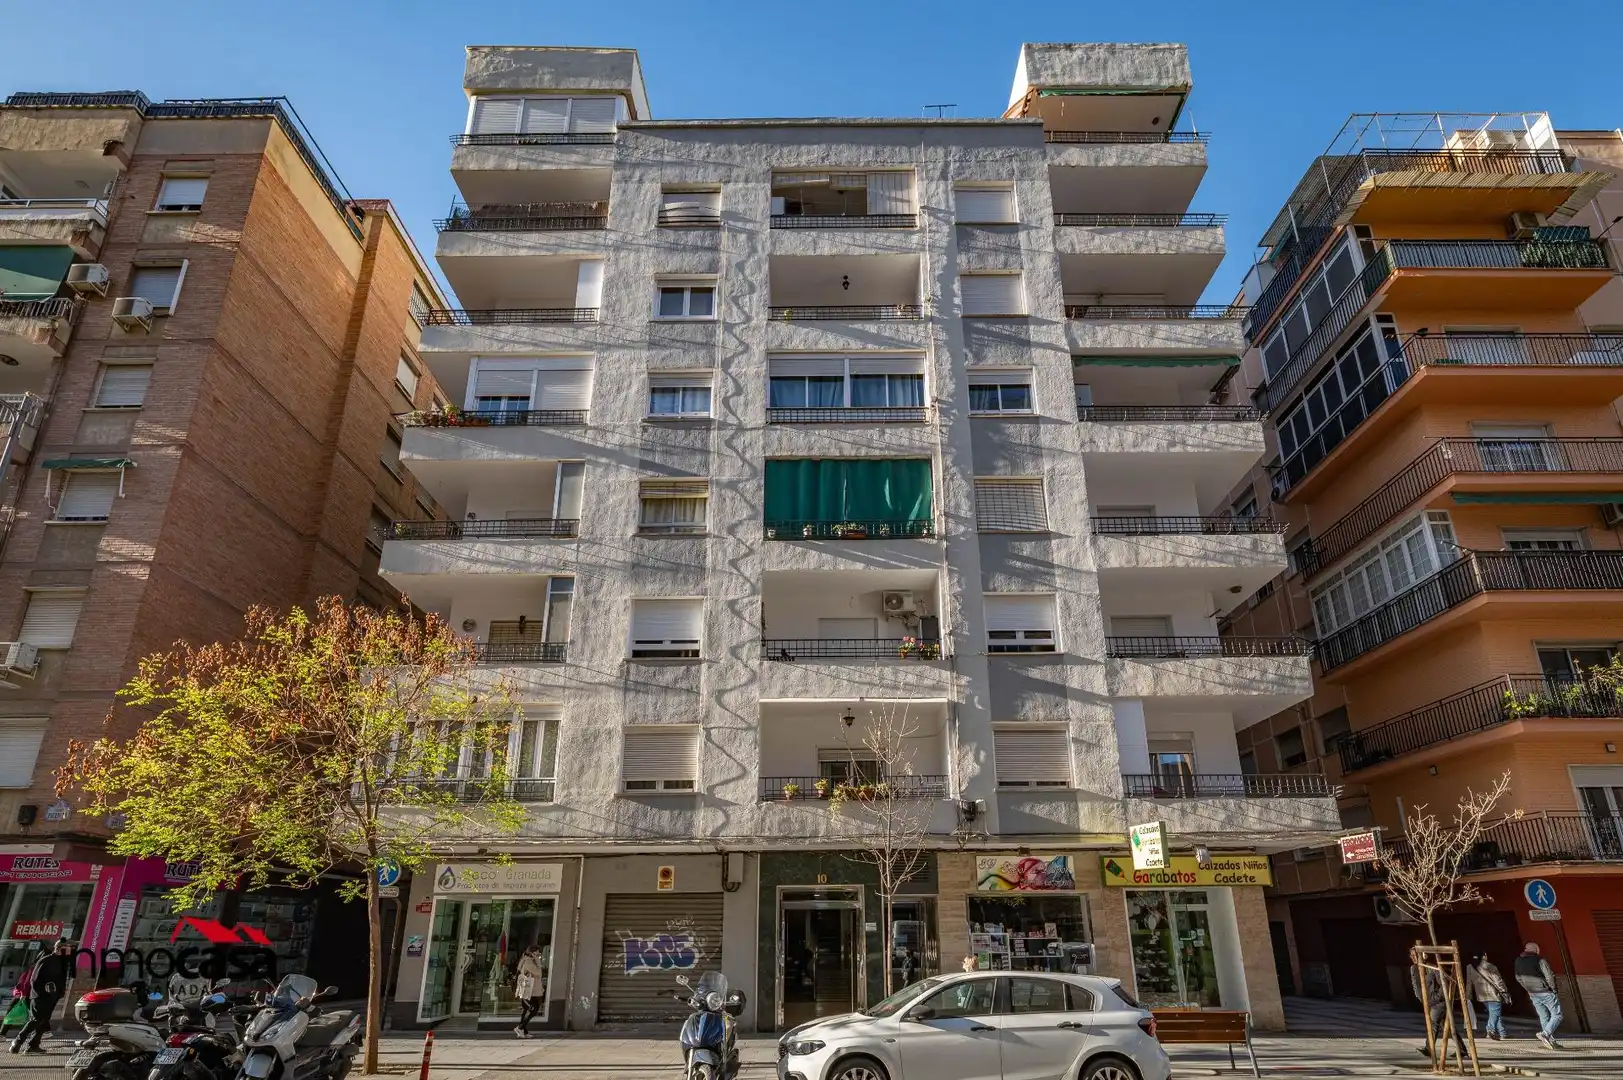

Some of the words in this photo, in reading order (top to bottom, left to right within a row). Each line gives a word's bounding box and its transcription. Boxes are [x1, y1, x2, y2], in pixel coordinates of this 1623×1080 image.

[1199, 860, 1241, 871] Calzados
[1243, 859, 1267, 870] Niños
[505, 868, 552, 880] Granada
[816, 873, 828, 884] 10
[1133, 870, 1197, 884] Garabatos
[1214, 872, 1256, 884] Cadete
[15, 924, 60, 936] REBAJAS
